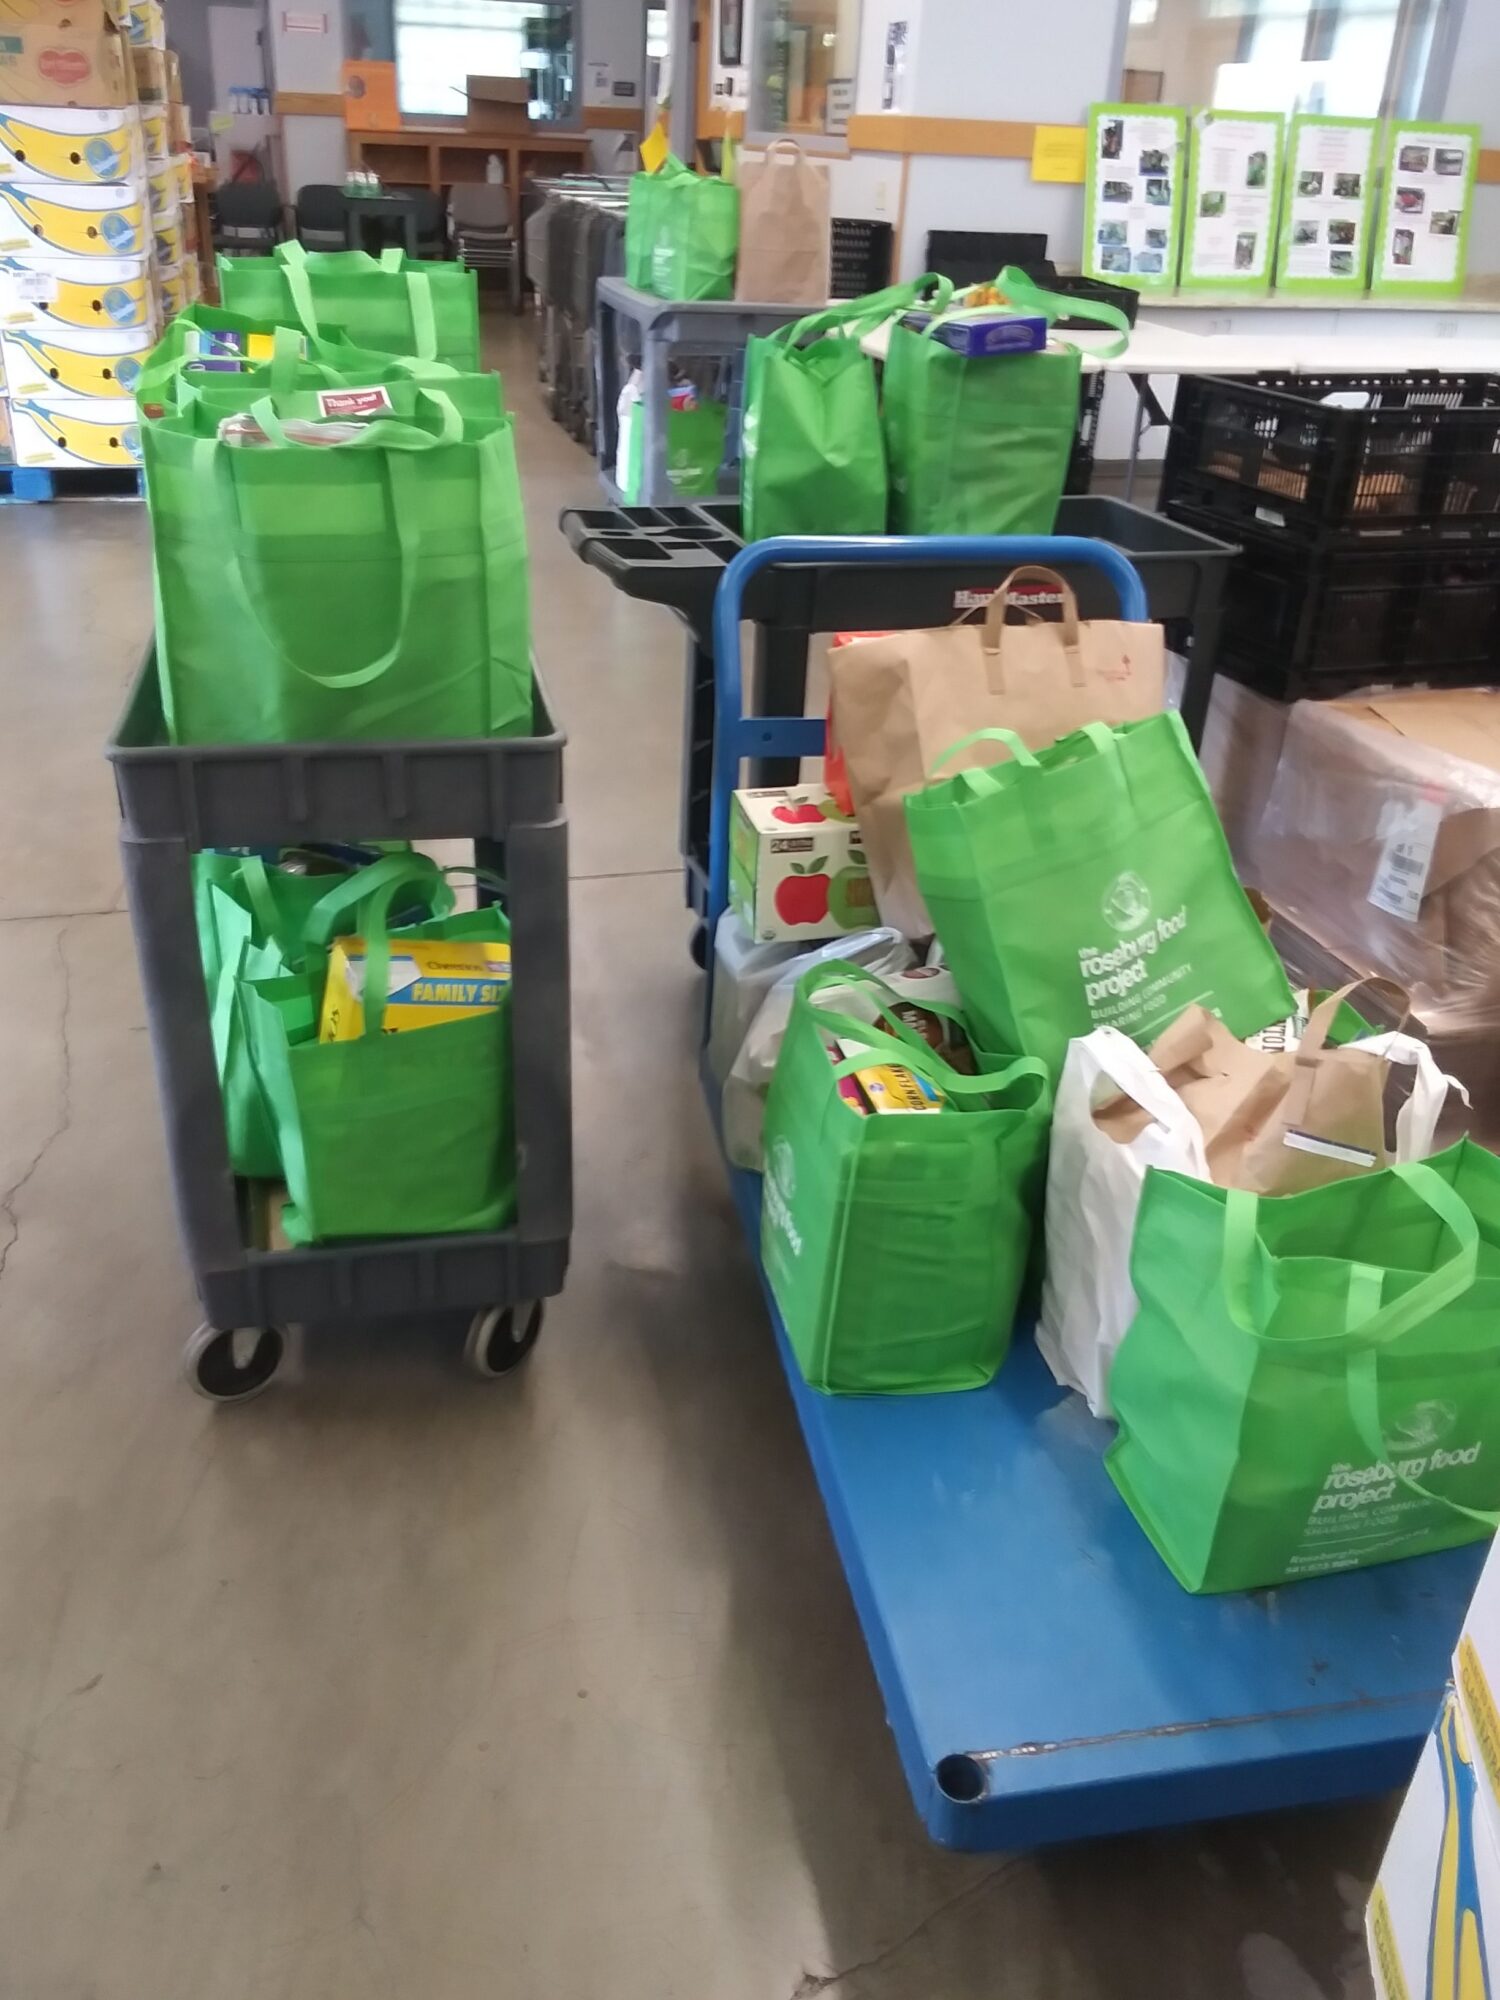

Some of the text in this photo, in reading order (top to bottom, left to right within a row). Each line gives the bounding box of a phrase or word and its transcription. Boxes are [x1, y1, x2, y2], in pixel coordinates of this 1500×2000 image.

[1079, 904, 1187, 978] roseburg food
[412, 983, 477, 1002] FAMILY
[1085, 958, 1149, 1006] project
[905, 1089, 927, 1110] CORN
[1428, 1441, 1482, 1471] food
[1311, 1481, 1396, 1514] project
